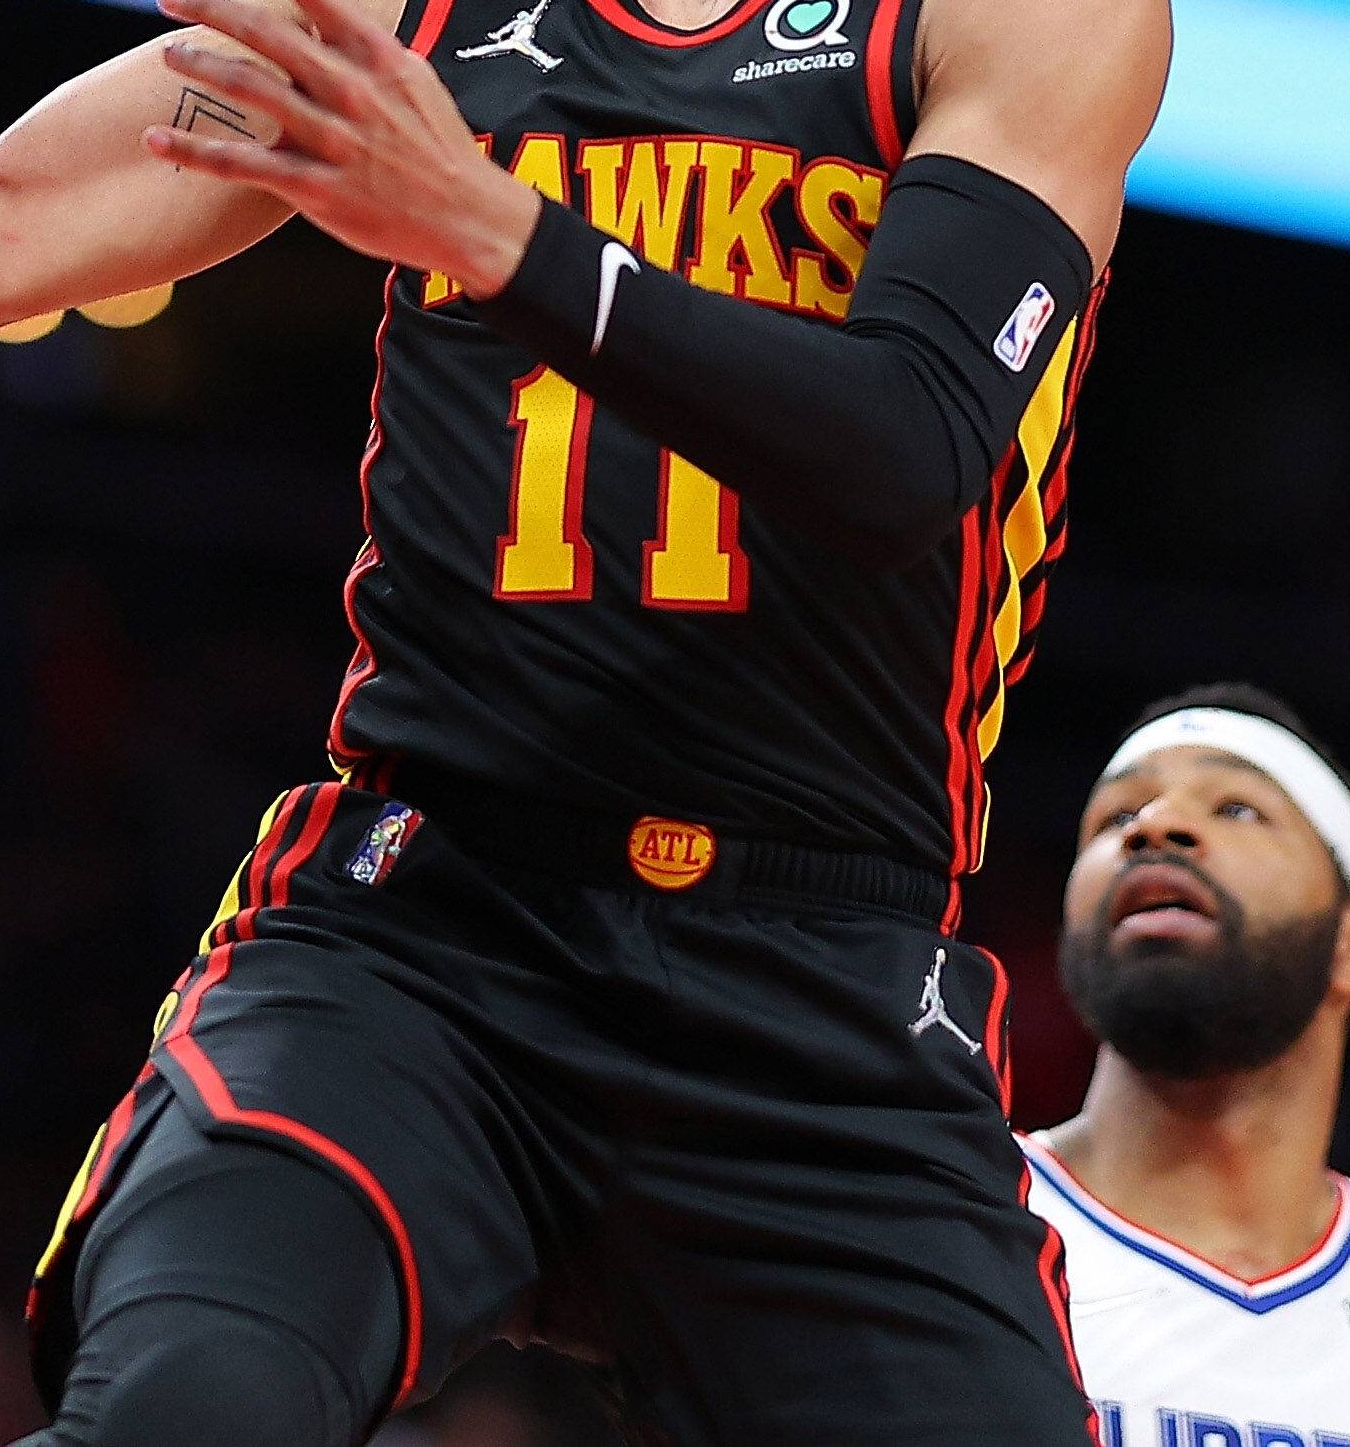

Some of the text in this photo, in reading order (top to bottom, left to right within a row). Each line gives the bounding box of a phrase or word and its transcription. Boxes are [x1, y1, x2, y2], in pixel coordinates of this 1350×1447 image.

[732, 51, 856, 83] sharecare
[492, 363, 749, 613] 11
[638, 828, 701, 865] ATL
